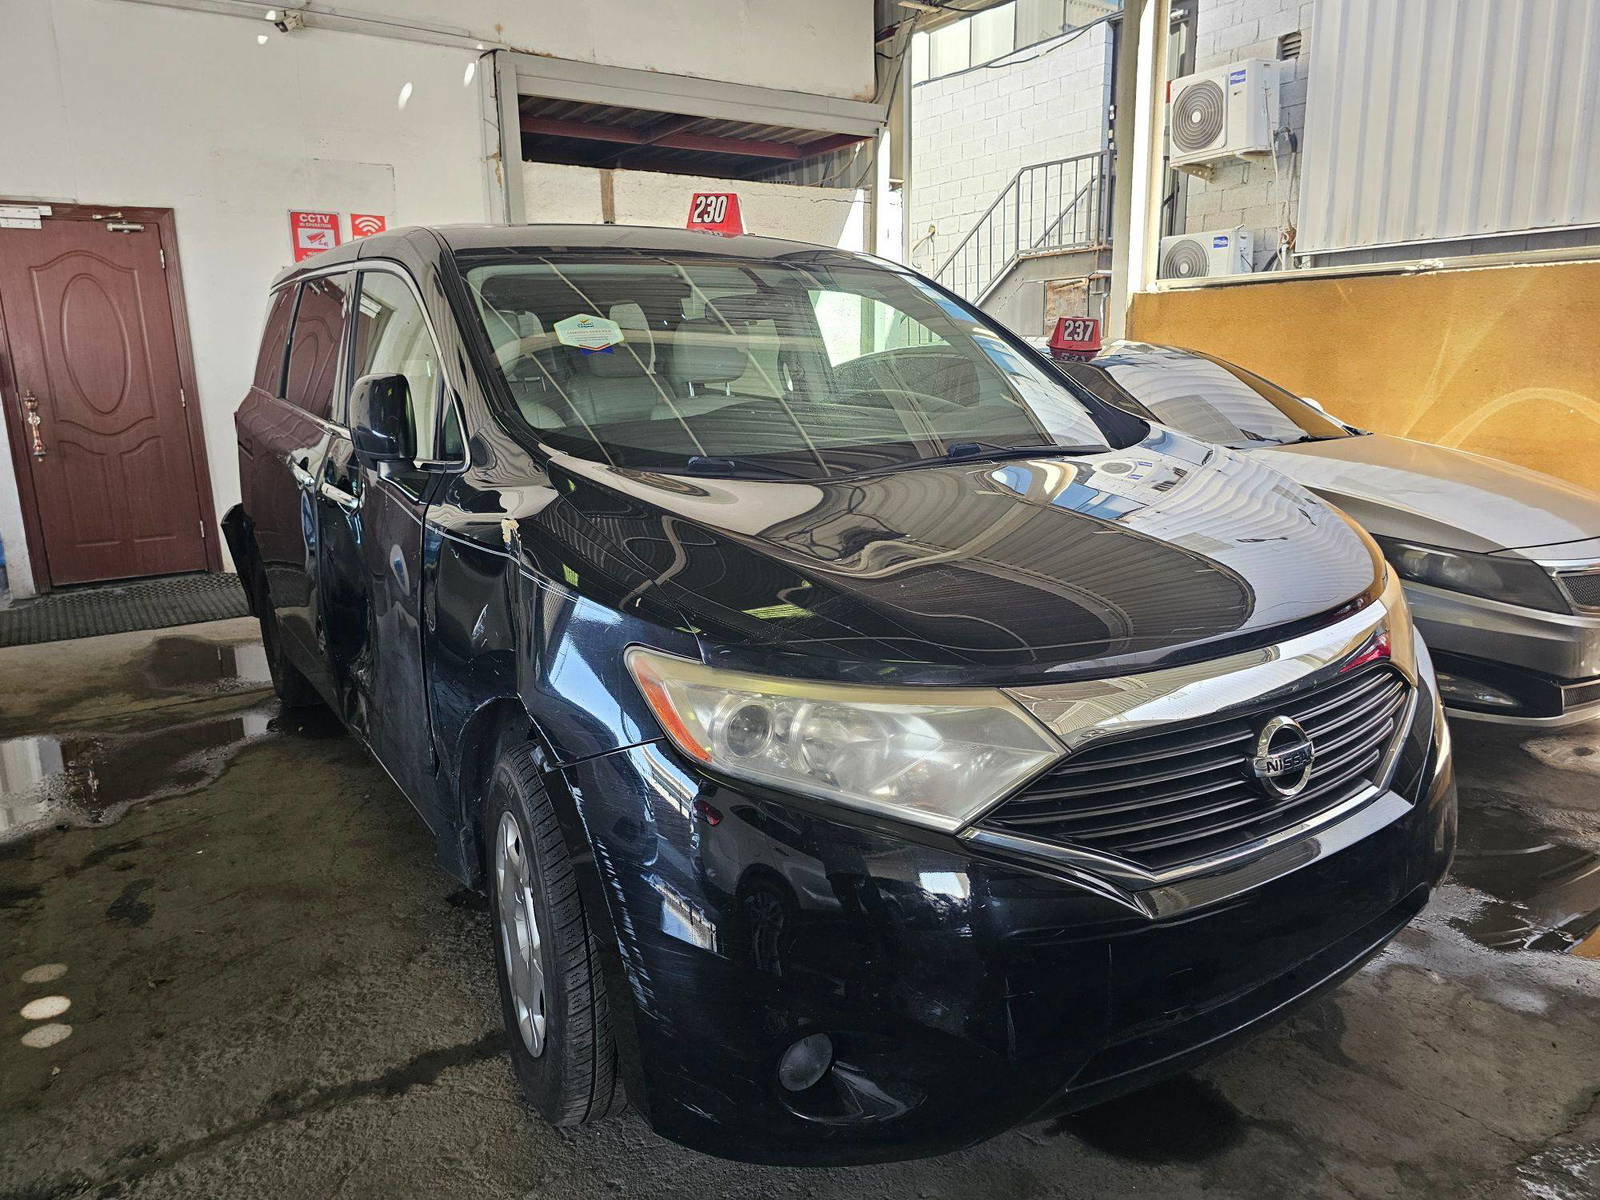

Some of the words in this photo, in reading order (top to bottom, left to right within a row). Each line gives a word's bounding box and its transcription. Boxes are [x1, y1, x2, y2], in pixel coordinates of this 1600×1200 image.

[299, 214, 330, 223] CCTV
[693, 196, 728, 223] 230
[1063, 320, 1094, 341] 237
